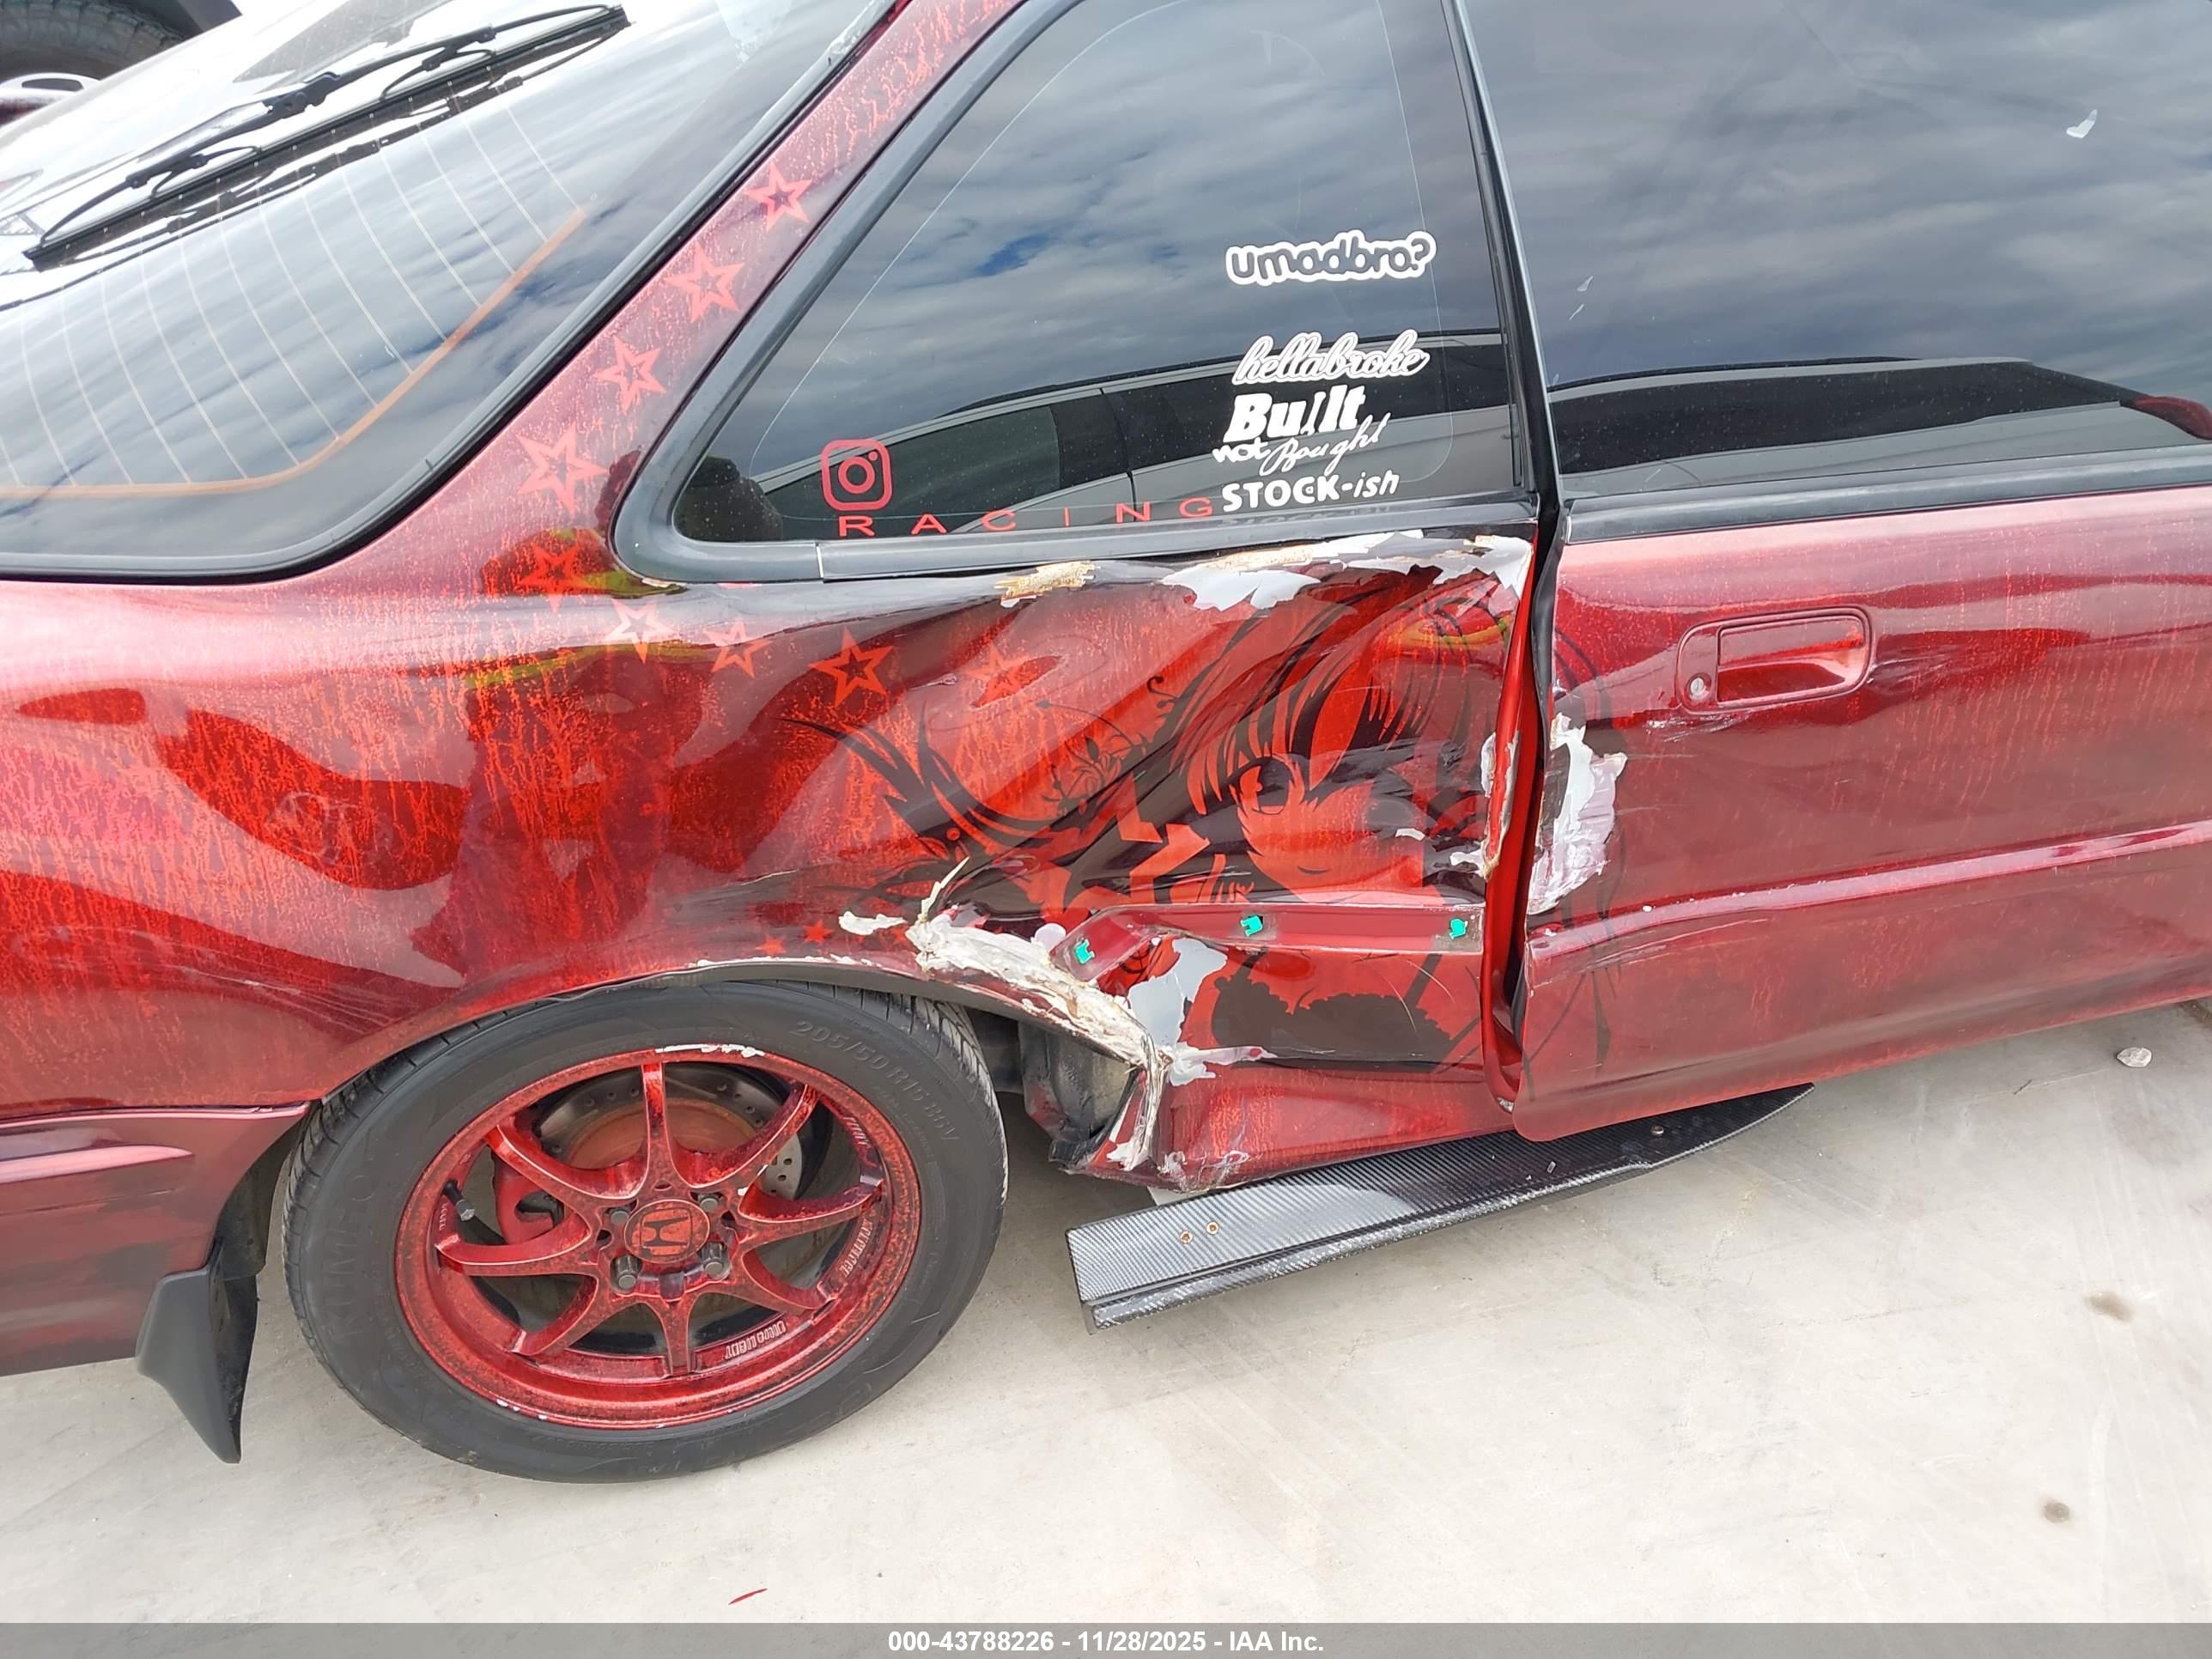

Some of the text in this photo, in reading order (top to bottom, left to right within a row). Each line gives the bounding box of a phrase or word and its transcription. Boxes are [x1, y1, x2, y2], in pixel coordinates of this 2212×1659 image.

[1226, 229, 1436, 286] umadbro?
[1231, 329, 1431, 385] hellabroke
[1222, 384, 1366, 443] Built
[837, 498, 1213, 538] RACING
[1221, 470, 1400, 513] STOCK-ish
